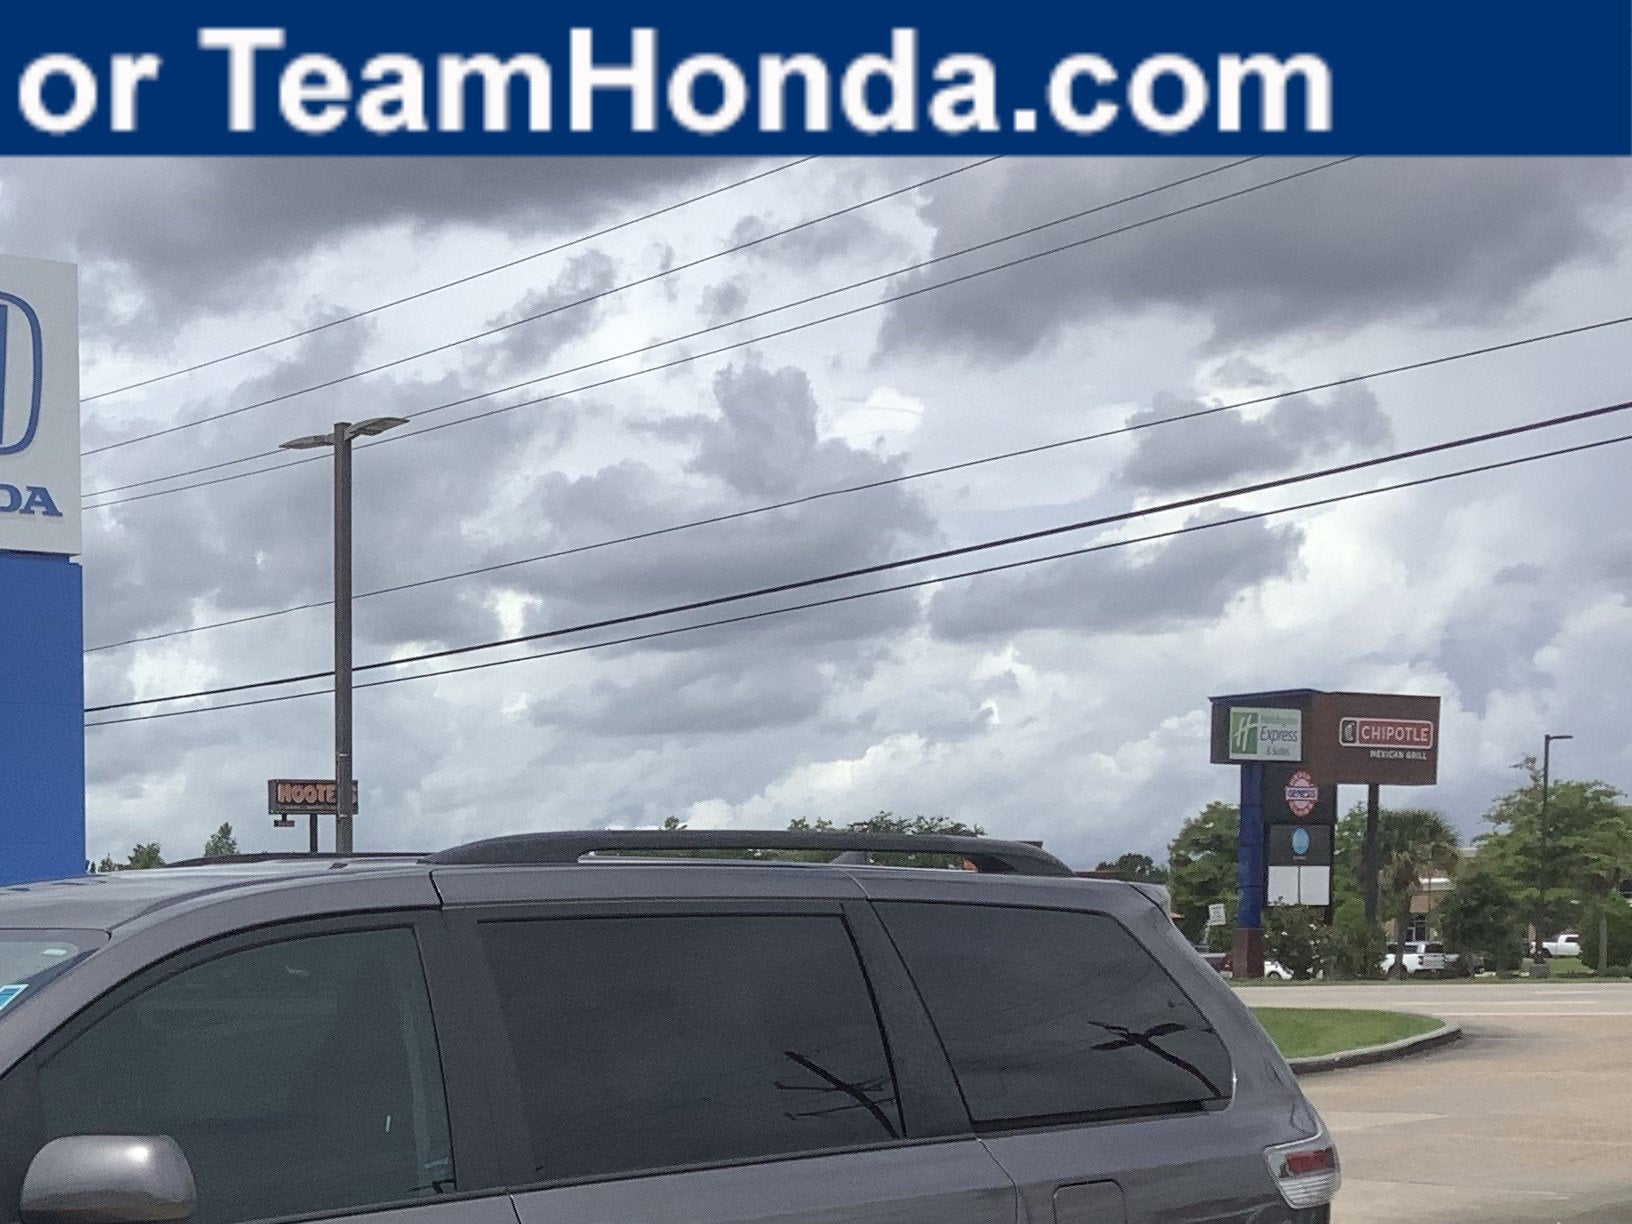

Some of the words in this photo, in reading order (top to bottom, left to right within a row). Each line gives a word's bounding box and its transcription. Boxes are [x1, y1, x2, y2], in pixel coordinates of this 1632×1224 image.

[1260, 726, 1299, 744] Express
[1361, 725, 1430, 742] CHIPOTLE
[1369, 750, 1404, 759] MEXICAN
[1405, 751, 1427, 760] GRILL
[277, 784, 357, 804] HOOTE
